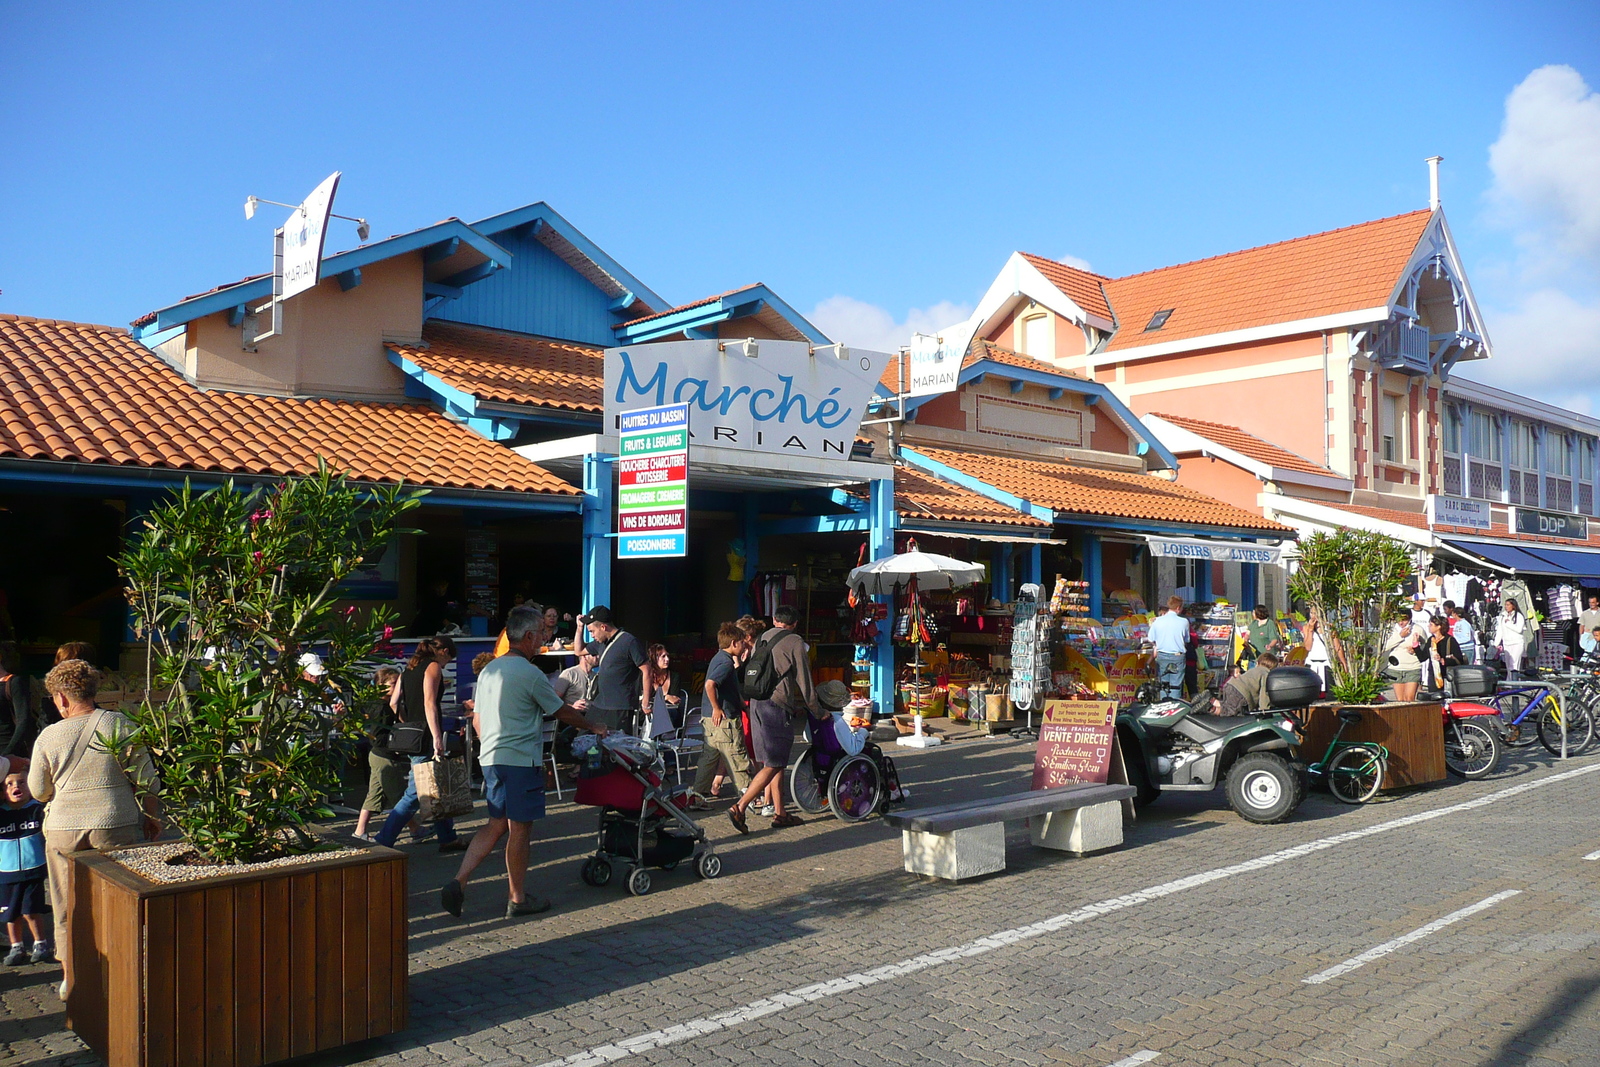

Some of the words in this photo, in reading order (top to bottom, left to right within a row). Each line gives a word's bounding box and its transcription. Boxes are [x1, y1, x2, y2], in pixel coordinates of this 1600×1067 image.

[285, 259, 315, 286] MARIAN
[912, 345, 963, 364] Marché
[913, 373, 954, 388] MARIAN
[614, 352, 852, 429] Marché
[622, 414, 649, 429] HUITRES
[650, 413, 660, 425] DU
[661, 409, 685, 424] BASSIN
[624, 438, 645, 452] FRUITS
[646, 438, 651, 449] &
[653, 434, 682, 448] LEGUMES
[621, 459, 649, 472] BOUCHERIE
[650, 455, 685, 469] CHARCUTERIE
[636, 470, 669, 484] ROTISSERIE
[621, 491, 656, 505] FROMAGERIE
[657, 489, 685, 502] CREMERIE
[623, 516, 637, 528] VINS
[638, 516, 646, 527] DE
[648, 513, 682, 527] BORDEAUX
[1540, 515, 1566, 533] DDP
[627, 538, 676, 551] POISSONNERIE
[1163, 542, 1210, 557] LOISIRS
[1231, 548, 1271, 561] LIVRES
[1116, 681, 1136, 692] envie
[1044, 731, 1072, 743] VENTE
[1074, 732, 1109, 745] DIRECTE
[1050, 743, 1093, 757] Producteur
